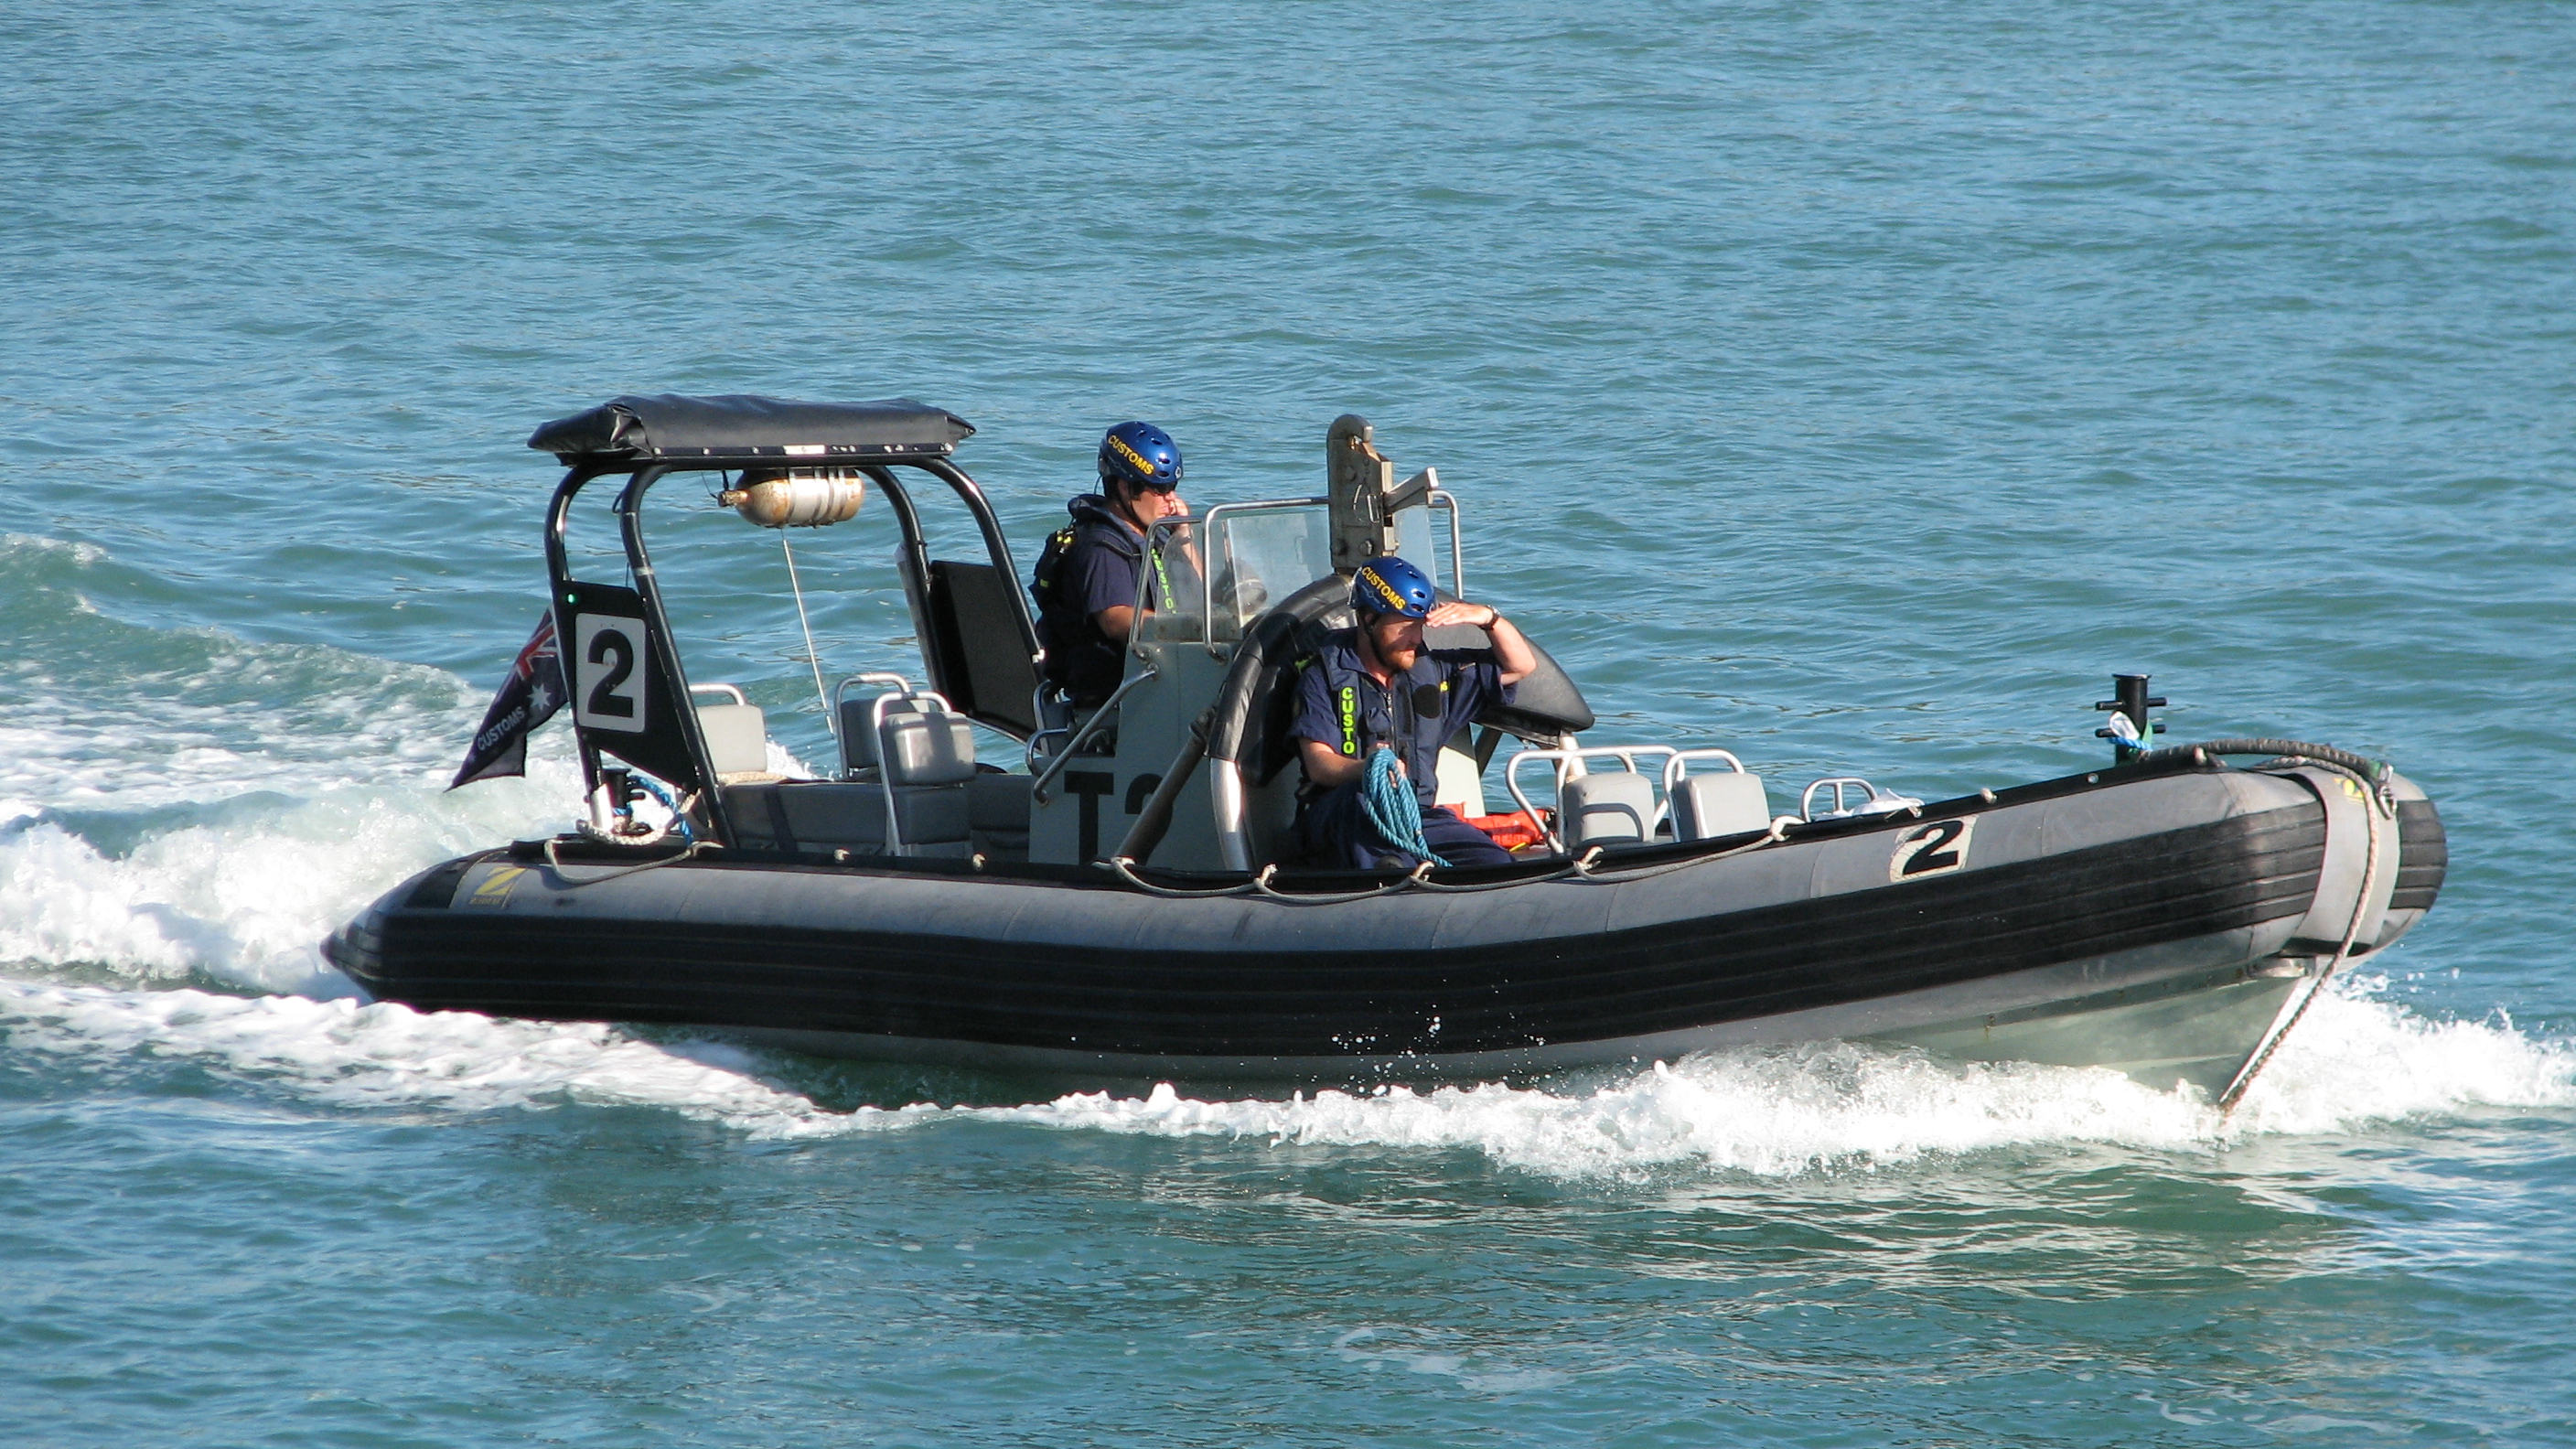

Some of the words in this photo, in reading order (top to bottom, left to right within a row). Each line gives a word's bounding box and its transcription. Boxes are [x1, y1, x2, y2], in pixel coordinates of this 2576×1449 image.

[1108, 435, 1155, 476] CUSTOMS
[1361, 566, 1406, 610] CUSTOMS
[587, 628, 634, 718] 2
[477, 705, 525, 751] CUSTOMS
[1902, 820, 1964, 875] 2
